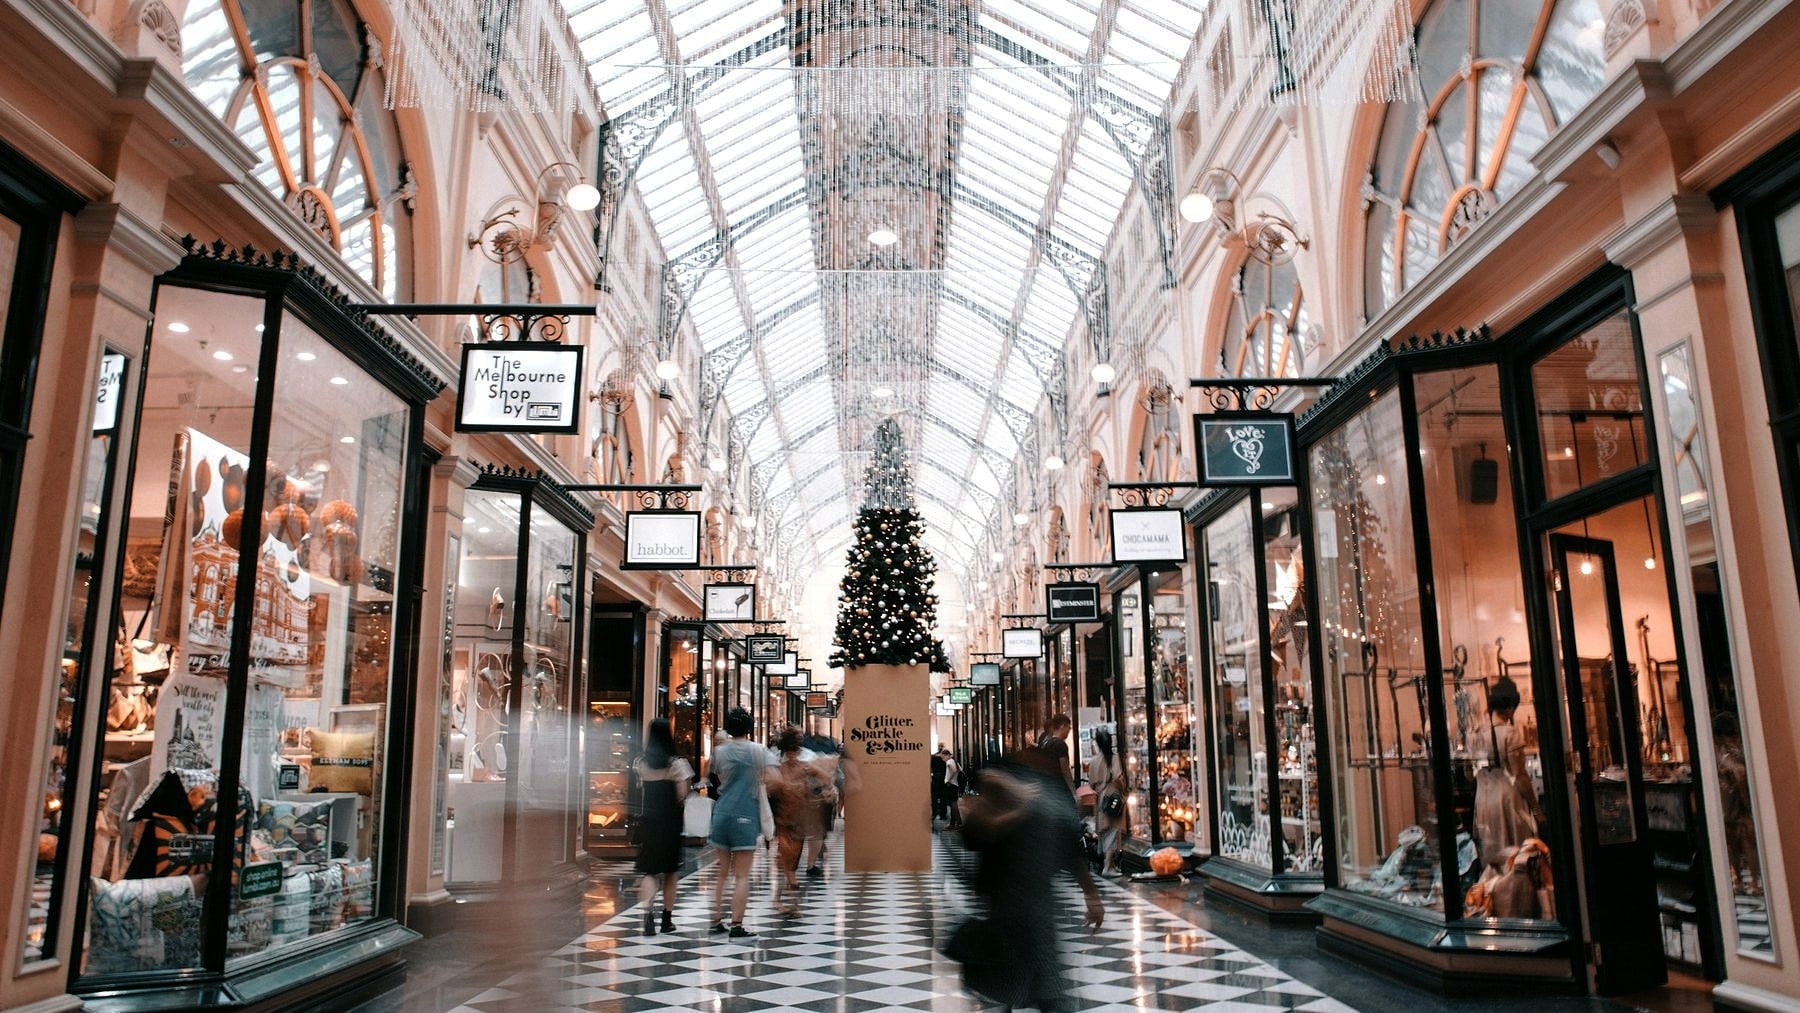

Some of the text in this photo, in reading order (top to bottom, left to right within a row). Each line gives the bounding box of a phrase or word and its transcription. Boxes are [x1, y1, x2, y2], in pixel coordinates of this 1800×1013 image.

[493, 356, 521, 369] The
[475, 367, 566, 383] Melbourne
[488, 384, 531, 402] Shop
[503, 400, 523, 417] by
[1122, 533, 1170, 544] CHOCAMAMA
[865, 715, 914, 730] Glitter.
[850, 728, 903, 742] Sparkle
